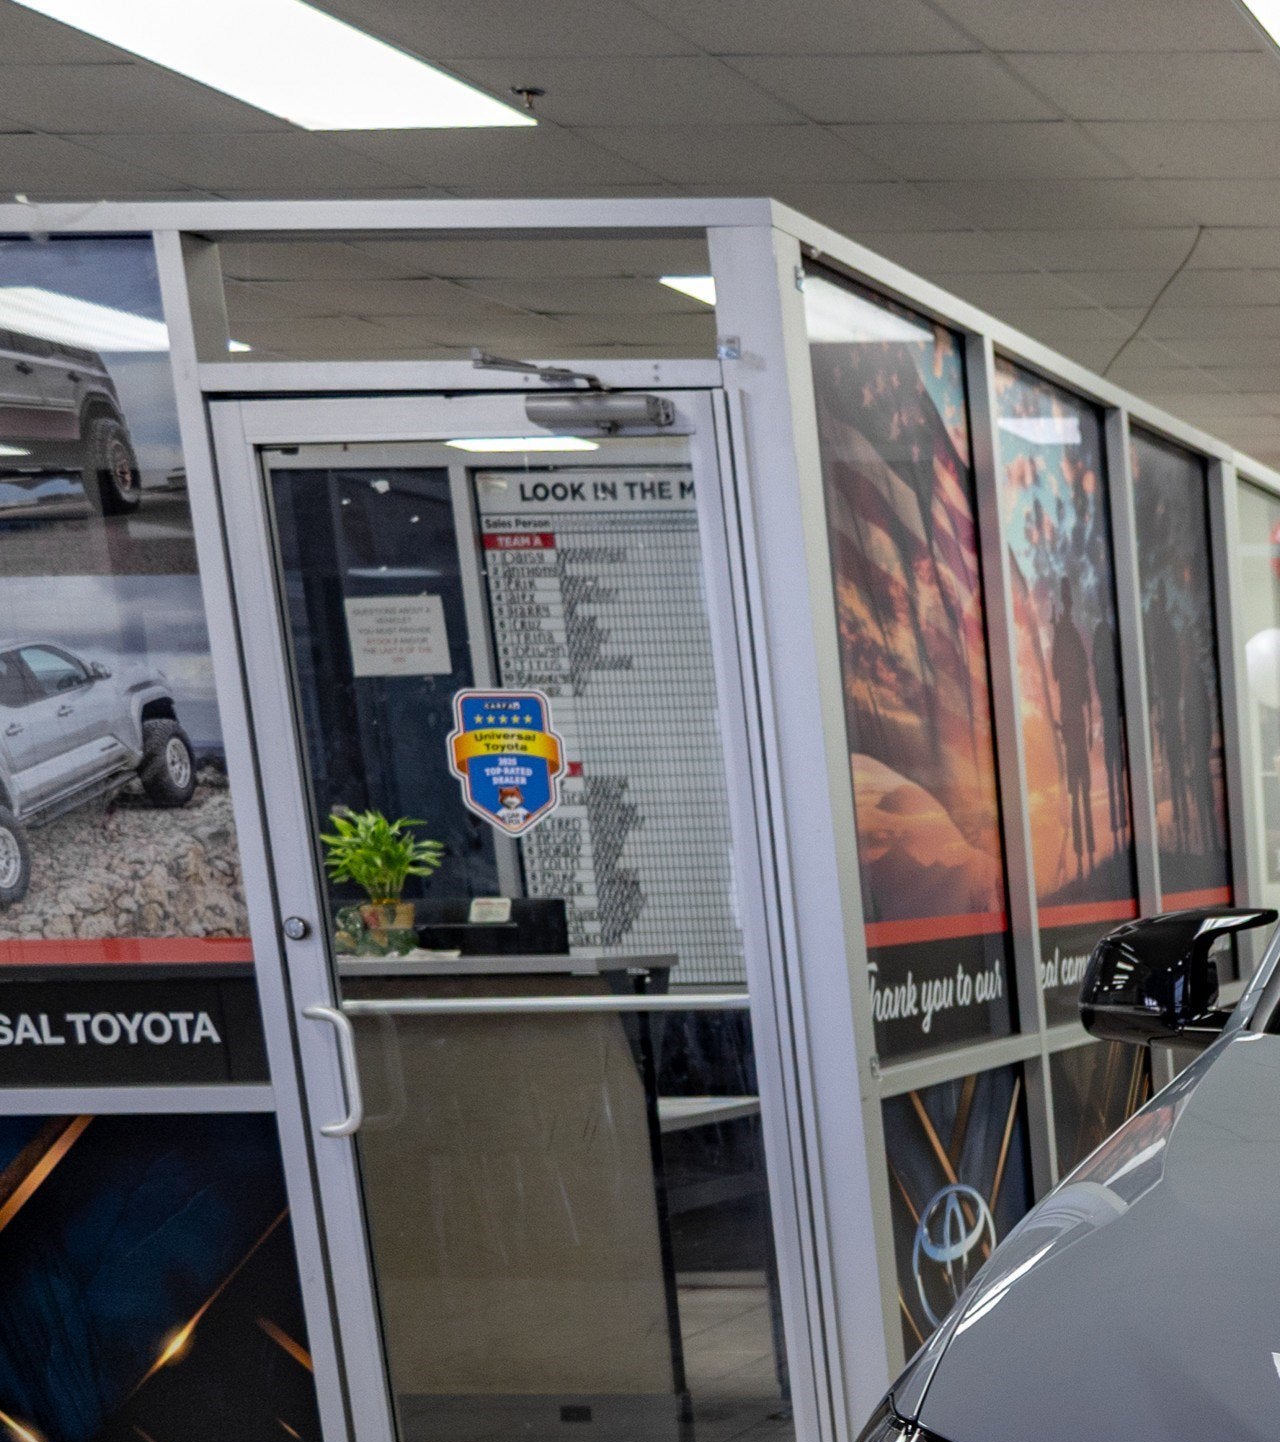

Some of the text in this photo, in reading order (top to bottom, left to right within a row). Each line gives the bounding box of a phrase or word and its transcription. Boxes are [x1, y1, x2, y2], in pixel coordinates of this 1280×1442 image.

[519, 482, 586, 501] LOOK
[593, 482, 617, 500] IN
[624, 481, 673, 500] THE
[485, 518, 512, 529] Sales
[514, 516, 551, 528] Person
[496, 537, 543, 547] TEAM A
[474, 732, 537, 743] Universal
[484, 742, 529, 753] Toyota
[484, 767, 534, 777] TOP-RATED
[492, 776, 528, 786] DEALER
[921, 976, 954, 1034] you
[956, 963, 973, 1006] to
[975, 959, 1003, 1003] our
[0, 1011, 222, 1046] SAL TOYOTA
